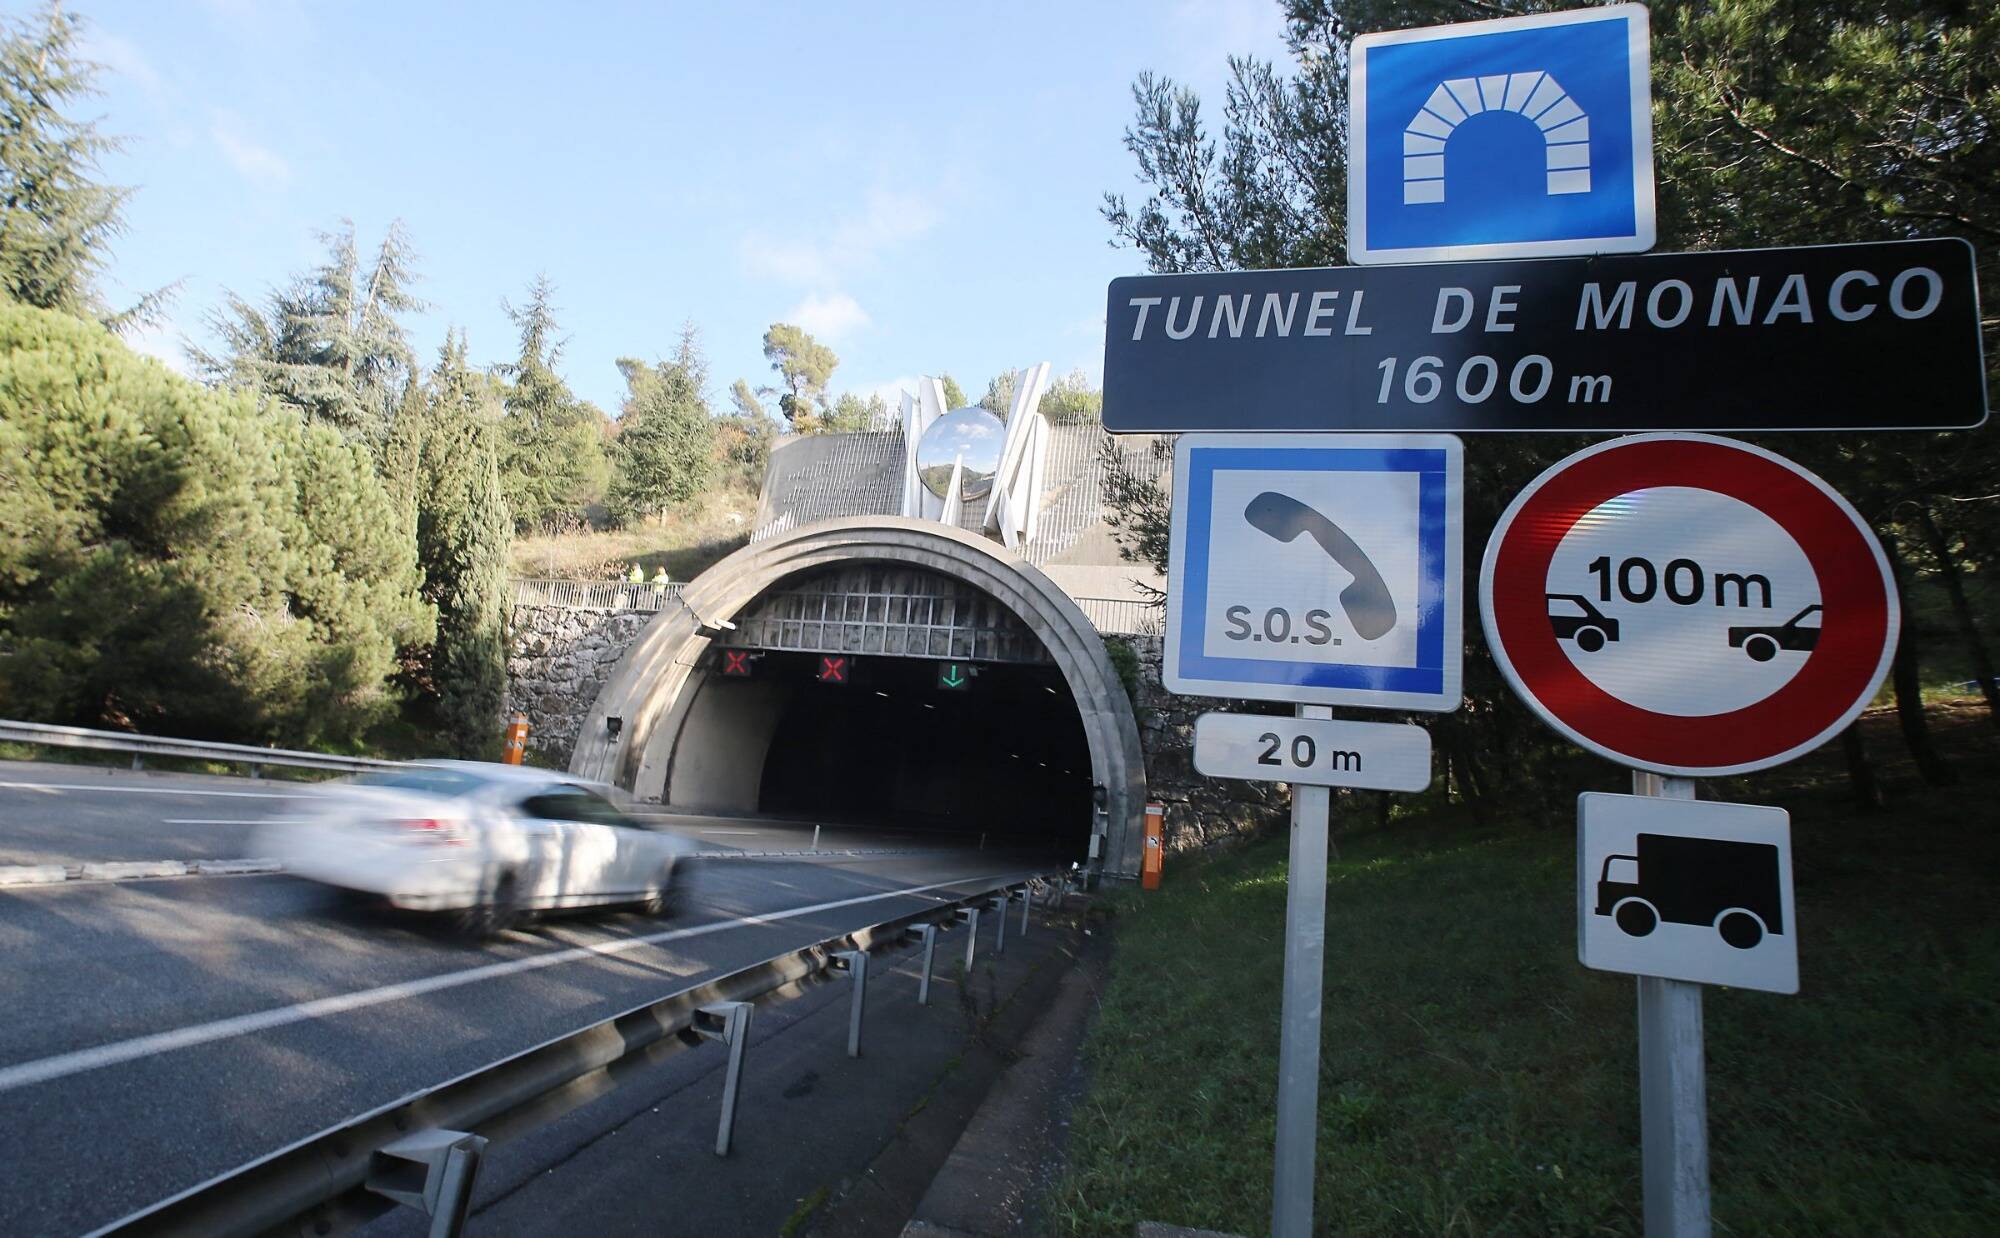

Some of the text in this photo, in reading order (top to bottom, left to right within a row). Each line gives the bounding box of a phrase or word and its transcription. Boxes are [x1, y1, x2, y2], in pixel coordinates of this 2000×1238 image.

[1129, 266, 1943, 341] TUNNEL DE MONACO
[1225, 605, 1342, 646] S.O.S.
[1258, 732, 1362, 772] 20 m
